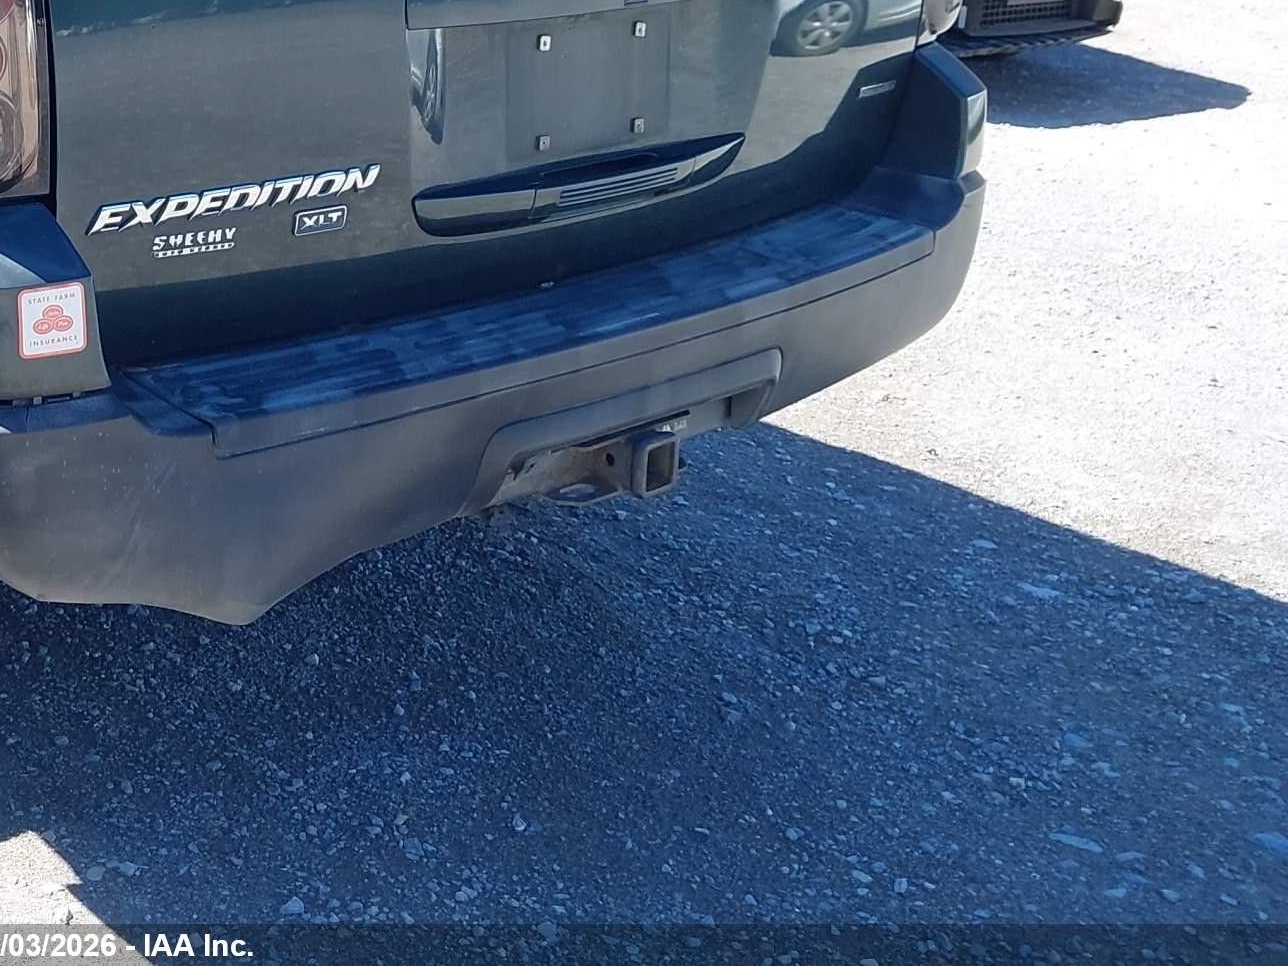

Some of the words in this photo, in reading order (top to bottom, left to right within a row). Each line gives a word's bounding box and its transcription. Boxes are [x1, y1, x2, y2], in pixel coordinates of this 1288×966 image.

[87, 163, 381, 236] EXPEDITION
[300, 211, 343, 231] XLT
[152, 227, 237, 251] SHEEHY
[28, 296, 50, 305] STATE
[54, 291, 76, 301] FARM
[29, 334, 78, 347] INSURANCE
